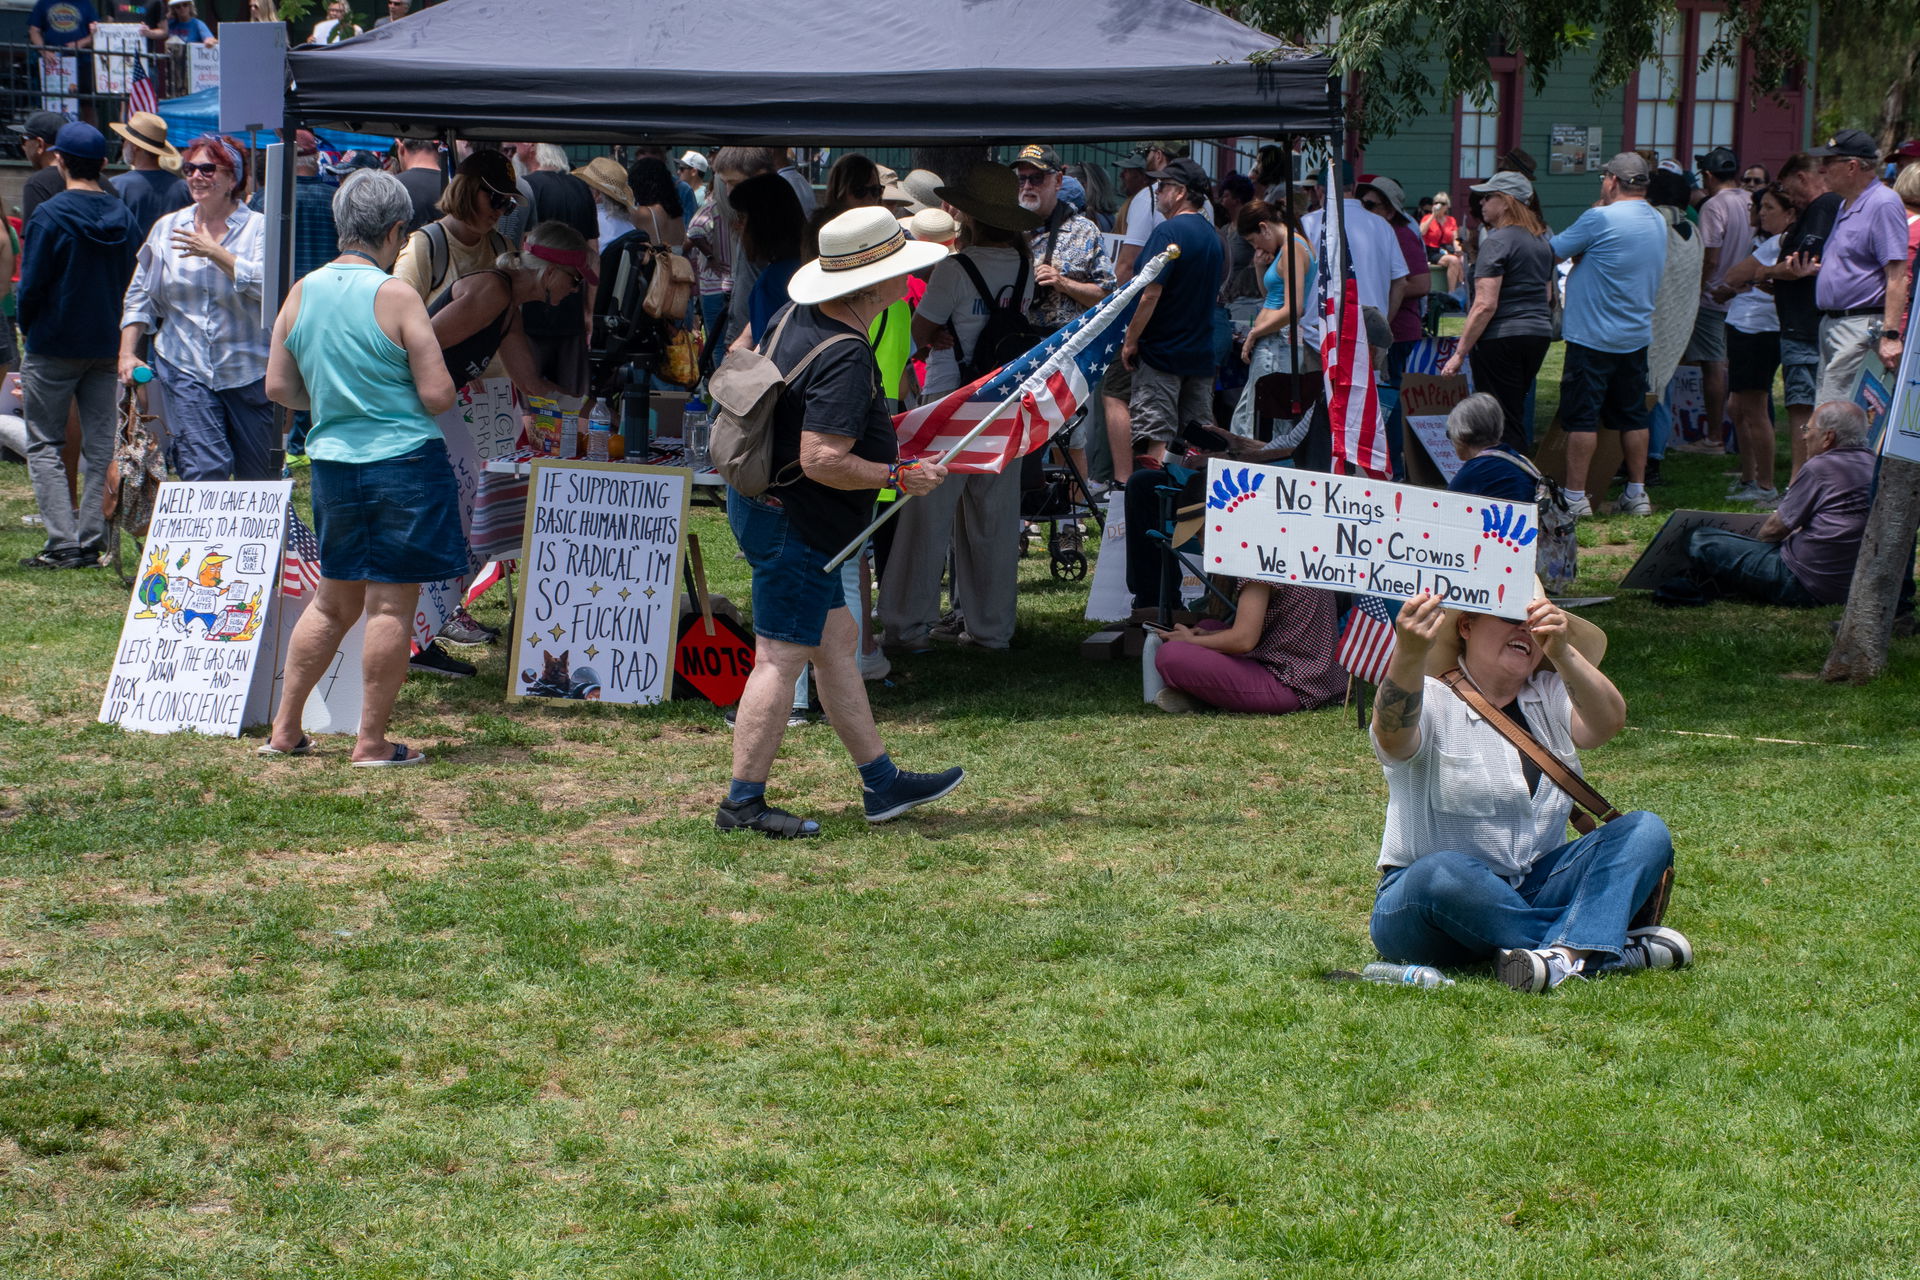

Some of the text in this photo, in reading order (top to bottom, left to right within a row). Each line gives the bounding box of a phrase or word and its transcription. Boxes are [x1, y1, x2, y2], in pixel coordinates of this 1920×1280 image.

[159, 488, 283, 514] WELP, YOU GAVE A BOX
[543, 472, 671, 509] IF SUPPORTING
[1275, 476, 1312, 511] No
[152, 516, 280, 540] OF MATCHES TO A TODDLER
[534, 506, 677, 545] BASIC HUMAN RIGHTS
[1336, 523, 1372, 557] No
[242, 555, 258, 563] DONE
[243, 547, 258, 555] WELL
[536, 541, 556, 573] IS
[646, 550, 671, 585] I'M
[1257, 545, 1287, 575] We
[1300, 550, 1357, 582] Won't
[1367, 562, 1422, 596] Kneel
[191, 602, 212, 610] MATTER
[536, 577, 569, 621] SO
[415, 612, 435, 644] NO
[571, 602, 661, 644] FUCKIN'
[119, 637, 182, 665] LET'S PUT
[180, 645, 250, 671] THE GAS CAN
[683, 646, 751, 677] SLOW
[145, 660, 178, 683] DOWN
[610, 648, 658, 693] RAD
[111, 674, 141, 701] PICK
[108, 701, 129, 724] UP
[131, 690, 243, 725] A CONSCIENCE
